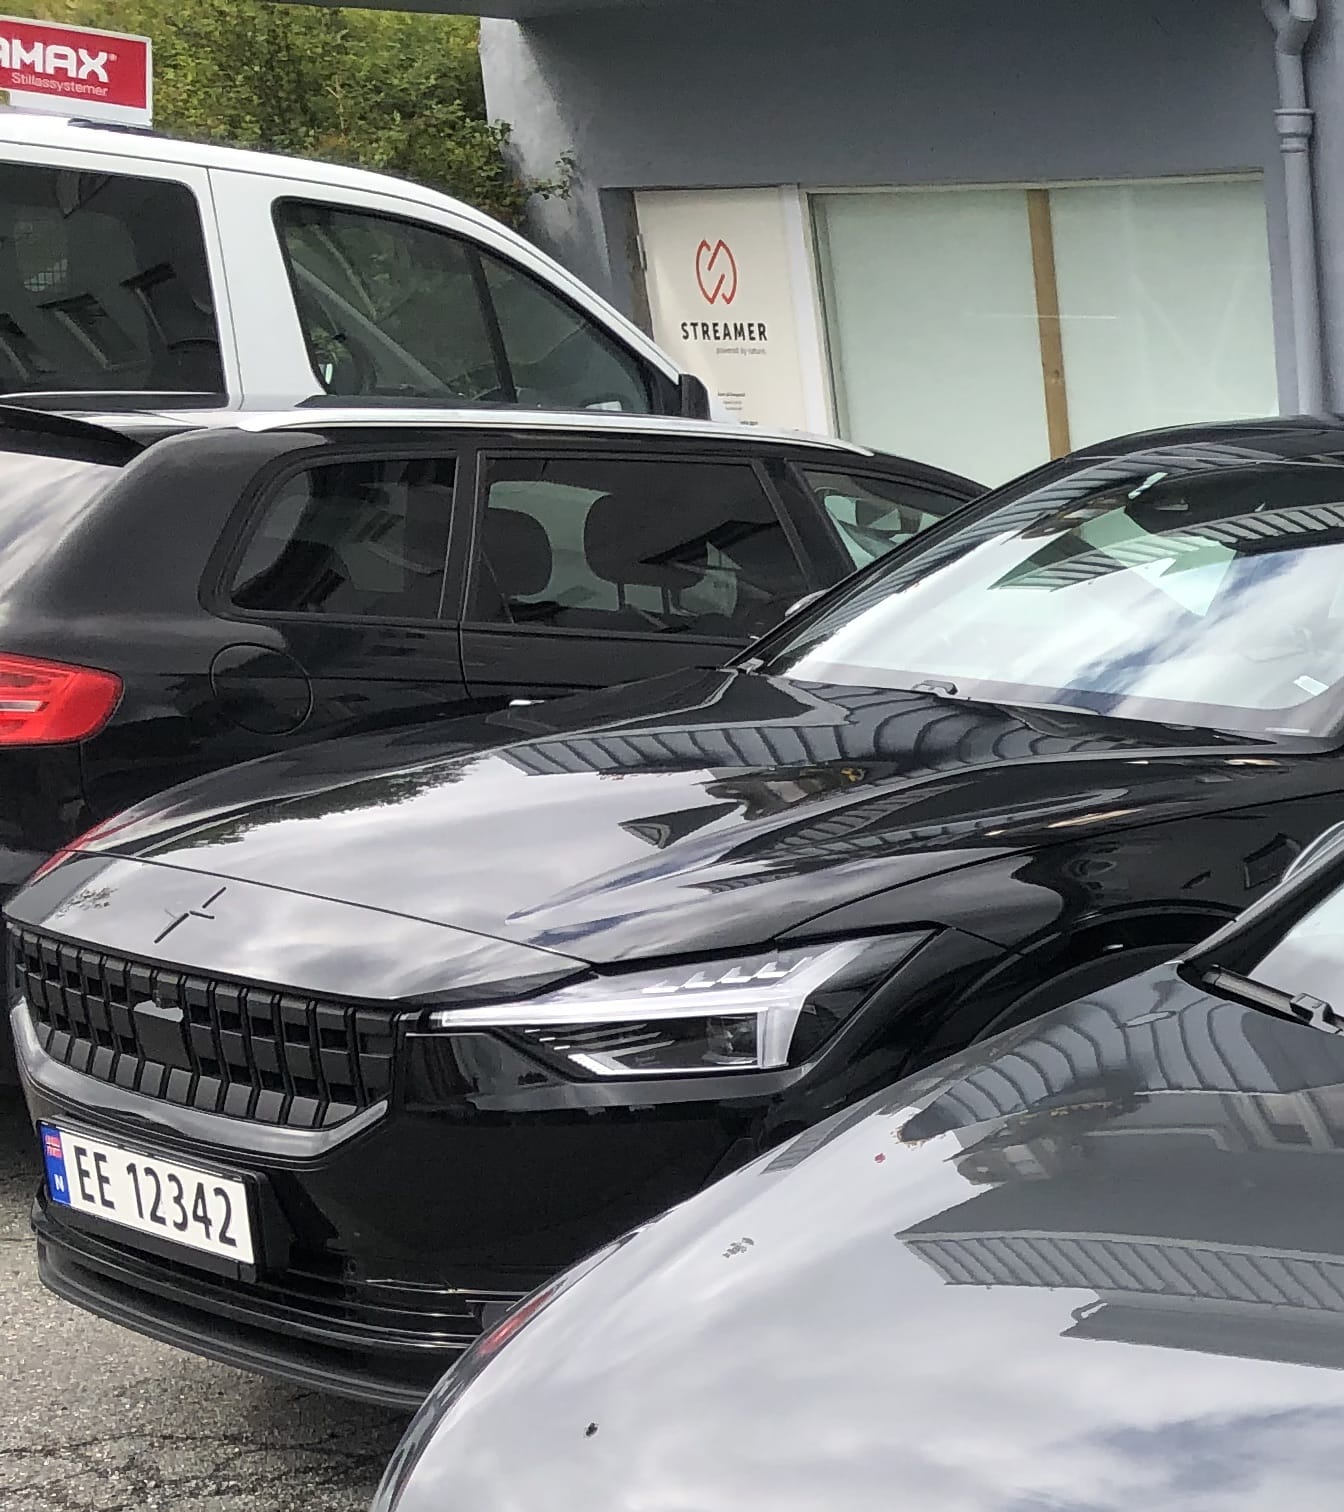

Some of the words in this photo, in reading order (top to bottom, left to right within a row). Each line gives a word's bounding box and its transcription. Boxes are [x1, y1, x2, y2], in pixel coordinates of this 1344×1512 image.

[11, 72, 109, 97] Stillassystemer
[680, 321, 768, 341] STREAMER
[54, 1174, 65, 1193] N
[73, 1145, 115, 1210] EE
[126, 1162, 238, 1248] 12342
